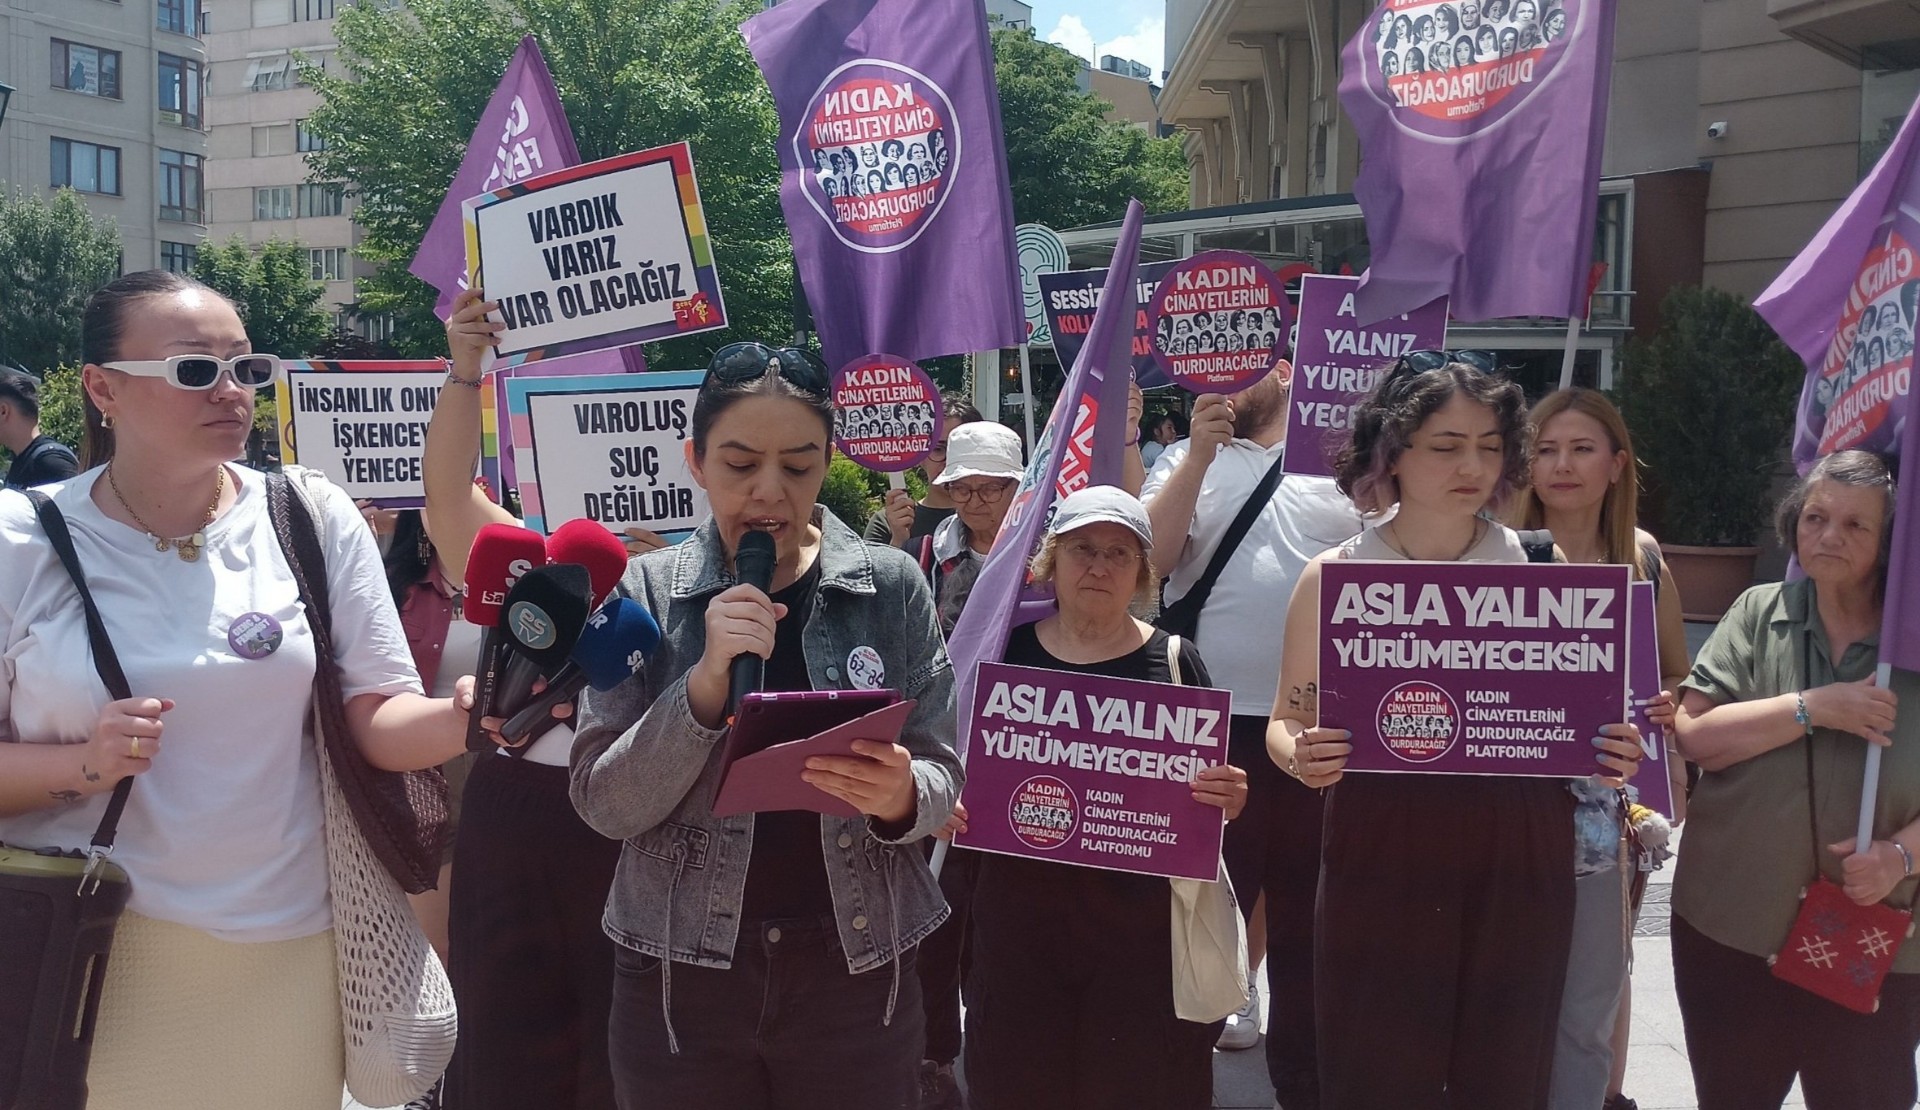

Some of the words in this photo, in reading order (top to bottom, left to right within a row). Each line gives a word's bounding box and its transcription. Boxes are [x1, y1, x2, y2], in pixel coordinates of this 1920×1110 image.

[527, 192, 624, 244] VARDIK
[542, 235, 622, 281] VARIZ
[1176, 266, 1256, 291] KADIN
[497, 290, 554, 331] VAR
[556, 259, 687, 320] OLACAĞIZ
[1164, 284, 1269, 312] CİNAYETLERİNİ
[1324, 328, 1417, 358] YALNIZ
[1173, 352, 1269, 376] DURDURACAĞIZ
[844, 367, 912, 388] KADIN
[298, 381, 394, 413] İNSANLIK
[837, 382, 924, 405] CİNAYETLERİNİ
[573, 398, 688, 440] VAROLUŞ
[849, 436, 929, 456] DURDURACAĞIZ
[342, 456, 424, 483] YENECE
[609, 445, 659, 487] SUÇ
[584, 482, 694, 523] DEĞİLDİR
[1330, 582, 1451, 626] ASLA
[1453, 585, 1616, 630] YALNIZ
[1331, 631, 1615, 673] YÜRÜMEYECEKSİN
[1387, 702, 1447, 714] CİNAYETLERİNİ
[1394, 691, 1441, 702] KADIN
[1465, 690, 1510, 704] KADIN
[981, 681, 1080, 729] ASLA
[1086, 694, 1221, 747] YALNIZ
[1465, 706, 1566, 725] CİNAYETLERİNİ
[1465, 725, 1576, 743] DURDURACAĞIZ
[980, 725, 1217, 783] YÜRÜMEYECEKSİN
[1465, 744, 1549, 760] PLATFORMU
[1027, 782, 1065, 797] KADIN
[1086, 789, 1124, 805] KADIN
[1084, 806, 1171, 828] CİNAYETLERİNİ
[1082, 821, 1178, 845] DURDURACAĞIZ
[1081, 837, 1152, 859] PLATFORMU
